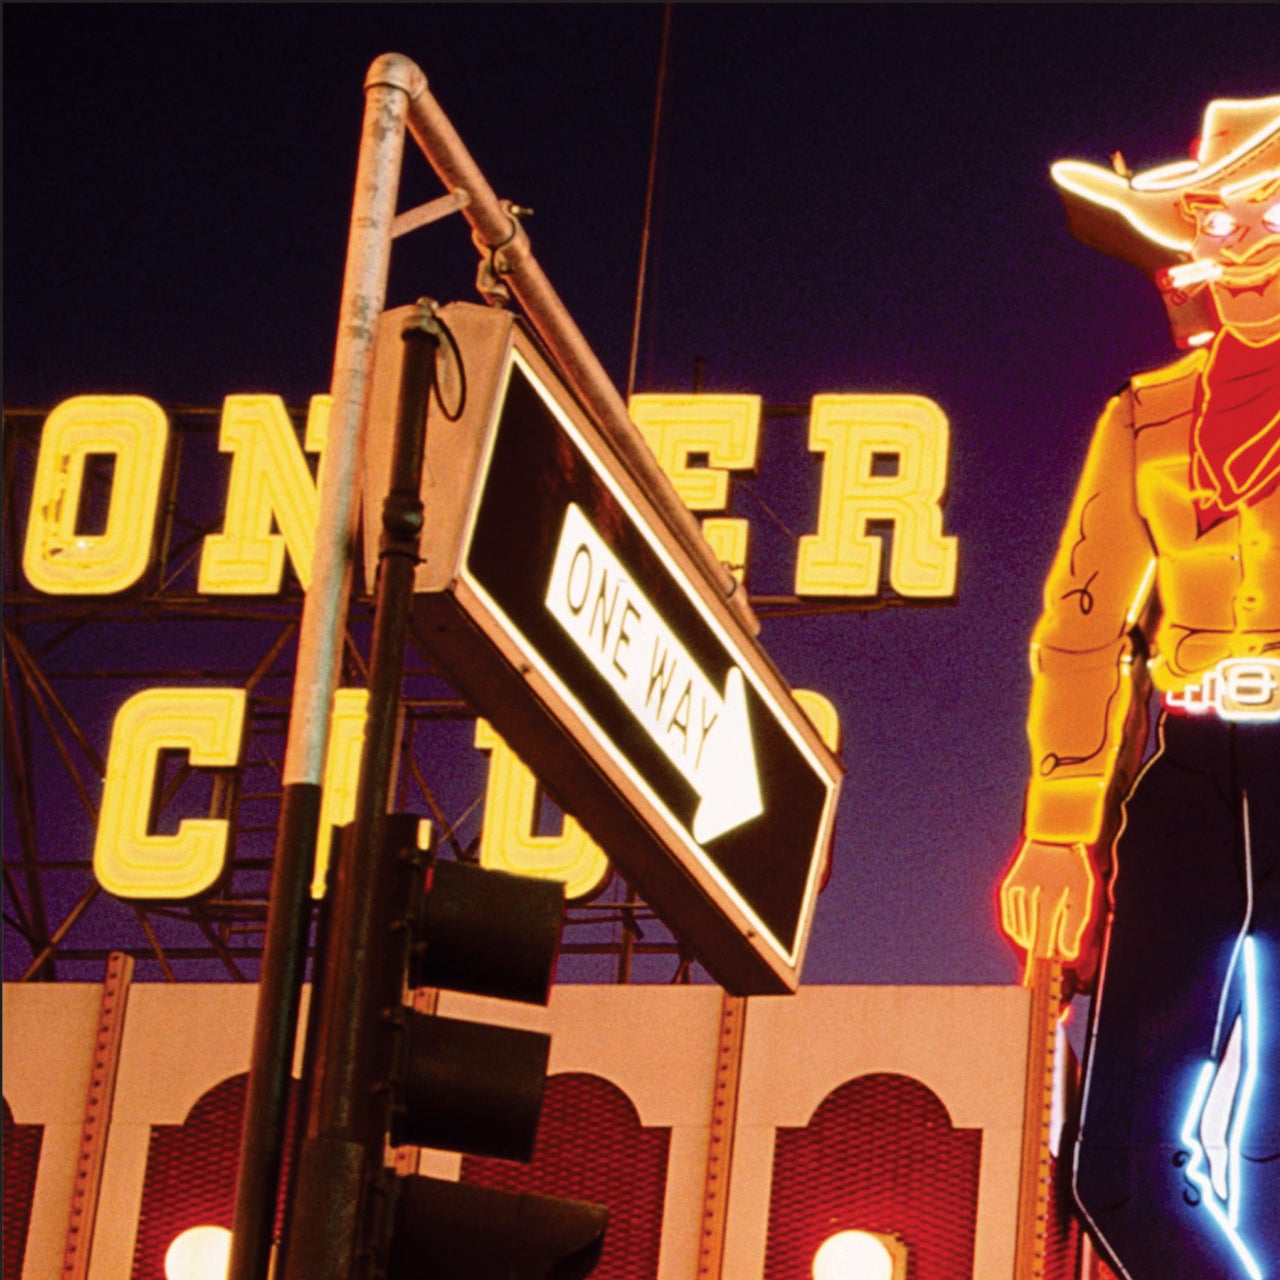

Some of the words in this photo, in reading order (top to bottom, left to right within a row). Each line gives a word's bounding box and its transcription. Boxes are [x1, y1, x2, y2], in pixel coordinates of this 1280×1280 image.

[23, 393, 958, 597] ONER
[566, 543, 641, 680] ONE
[645, 635, 719, 770] WAY
